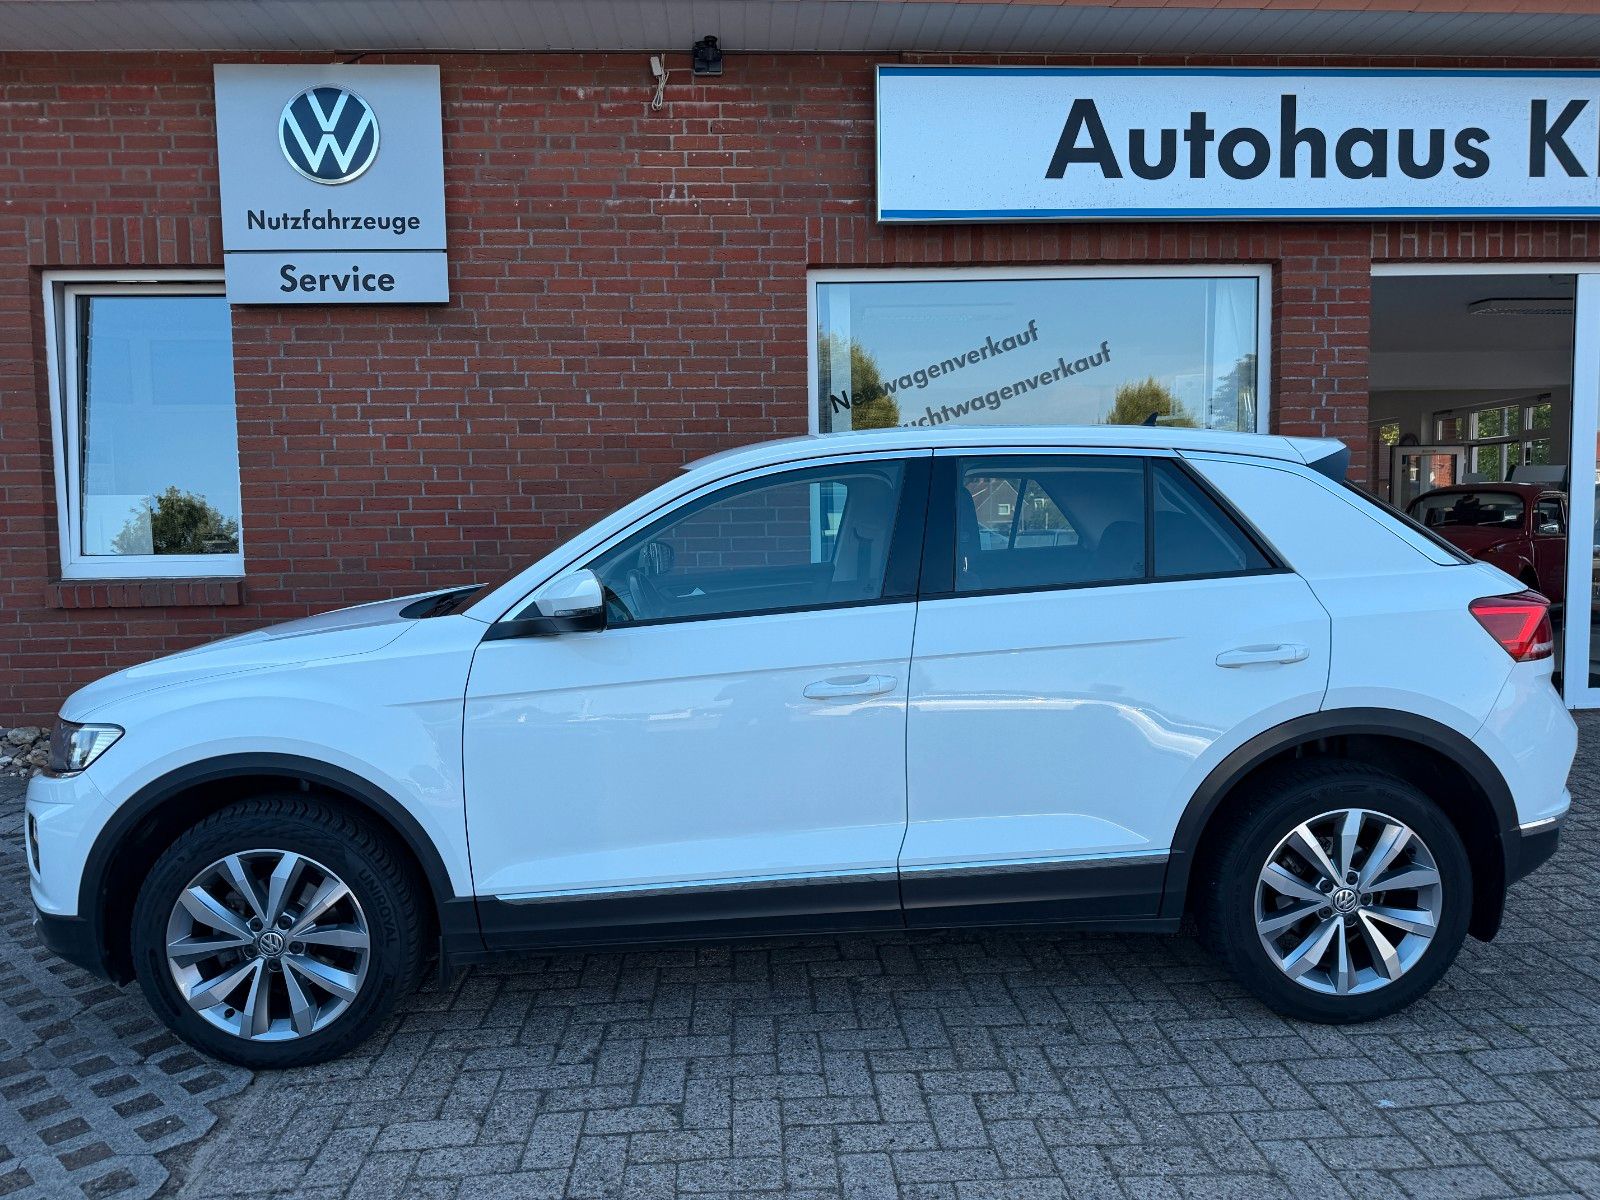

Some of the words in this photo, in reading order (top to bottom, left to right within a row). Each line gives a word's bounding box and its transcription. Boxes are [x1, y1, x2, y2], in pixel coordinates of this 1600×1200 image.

[280, 85, 378, 183] VW
[1043, 94, 1491, 181] Autohaus
[1529, 97, 1600, 179] K
[247, 208, 421, 235] Nutzfahrzeuge
[280, 264, 396, 293] Service
[897, 340, 1111, 428] chtwagenverkauf
[358, 867, 400, 948] UNIROYAL
